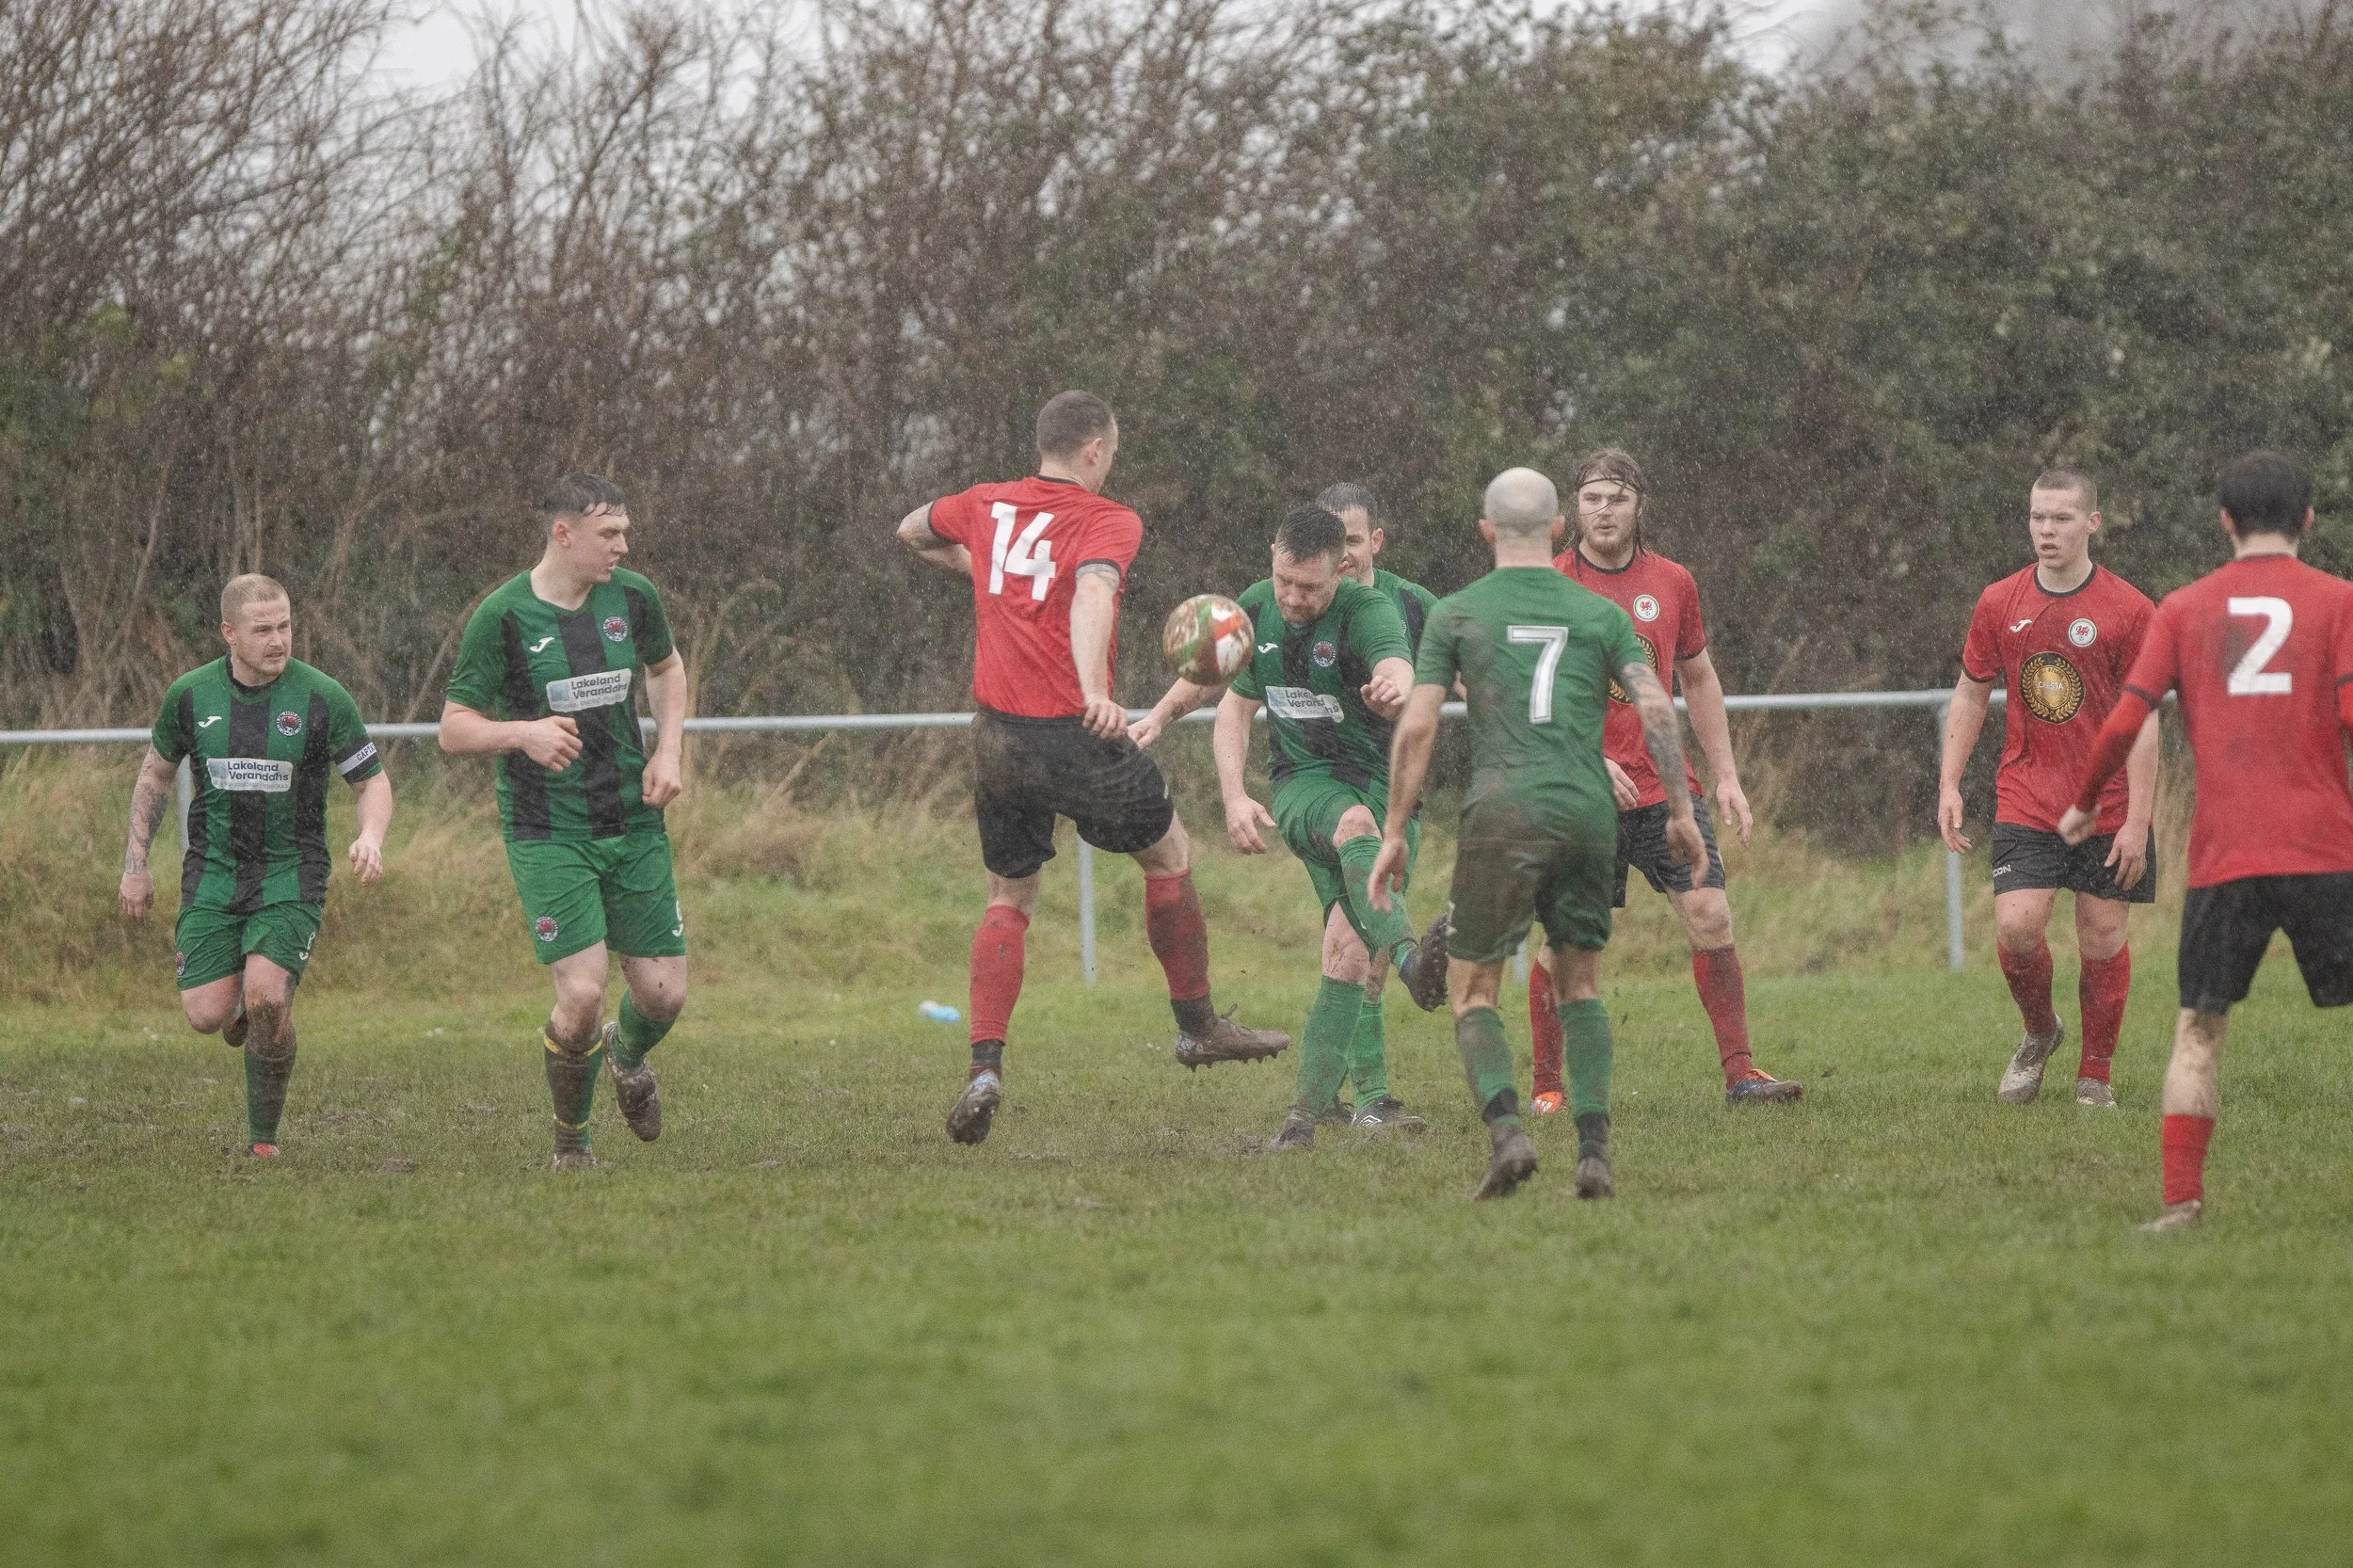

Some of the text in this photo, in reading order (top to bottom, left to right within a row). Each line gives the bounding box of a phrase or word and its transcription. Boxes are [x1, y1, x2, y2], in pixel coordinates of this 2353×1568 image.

[988, 502, 1056, 601] 14
[2227, 595, 2293, 696] 2
[571, 674, 620, 690] Lakeland
[1507, 625, 1569, 724] 7
[573, 683, 628, 699] Verandahs
[1285, 690, 1315, 699] Lake
[227, 760, 280, 772] Lakeland
[229, 771, 289, 782] Verandahs
